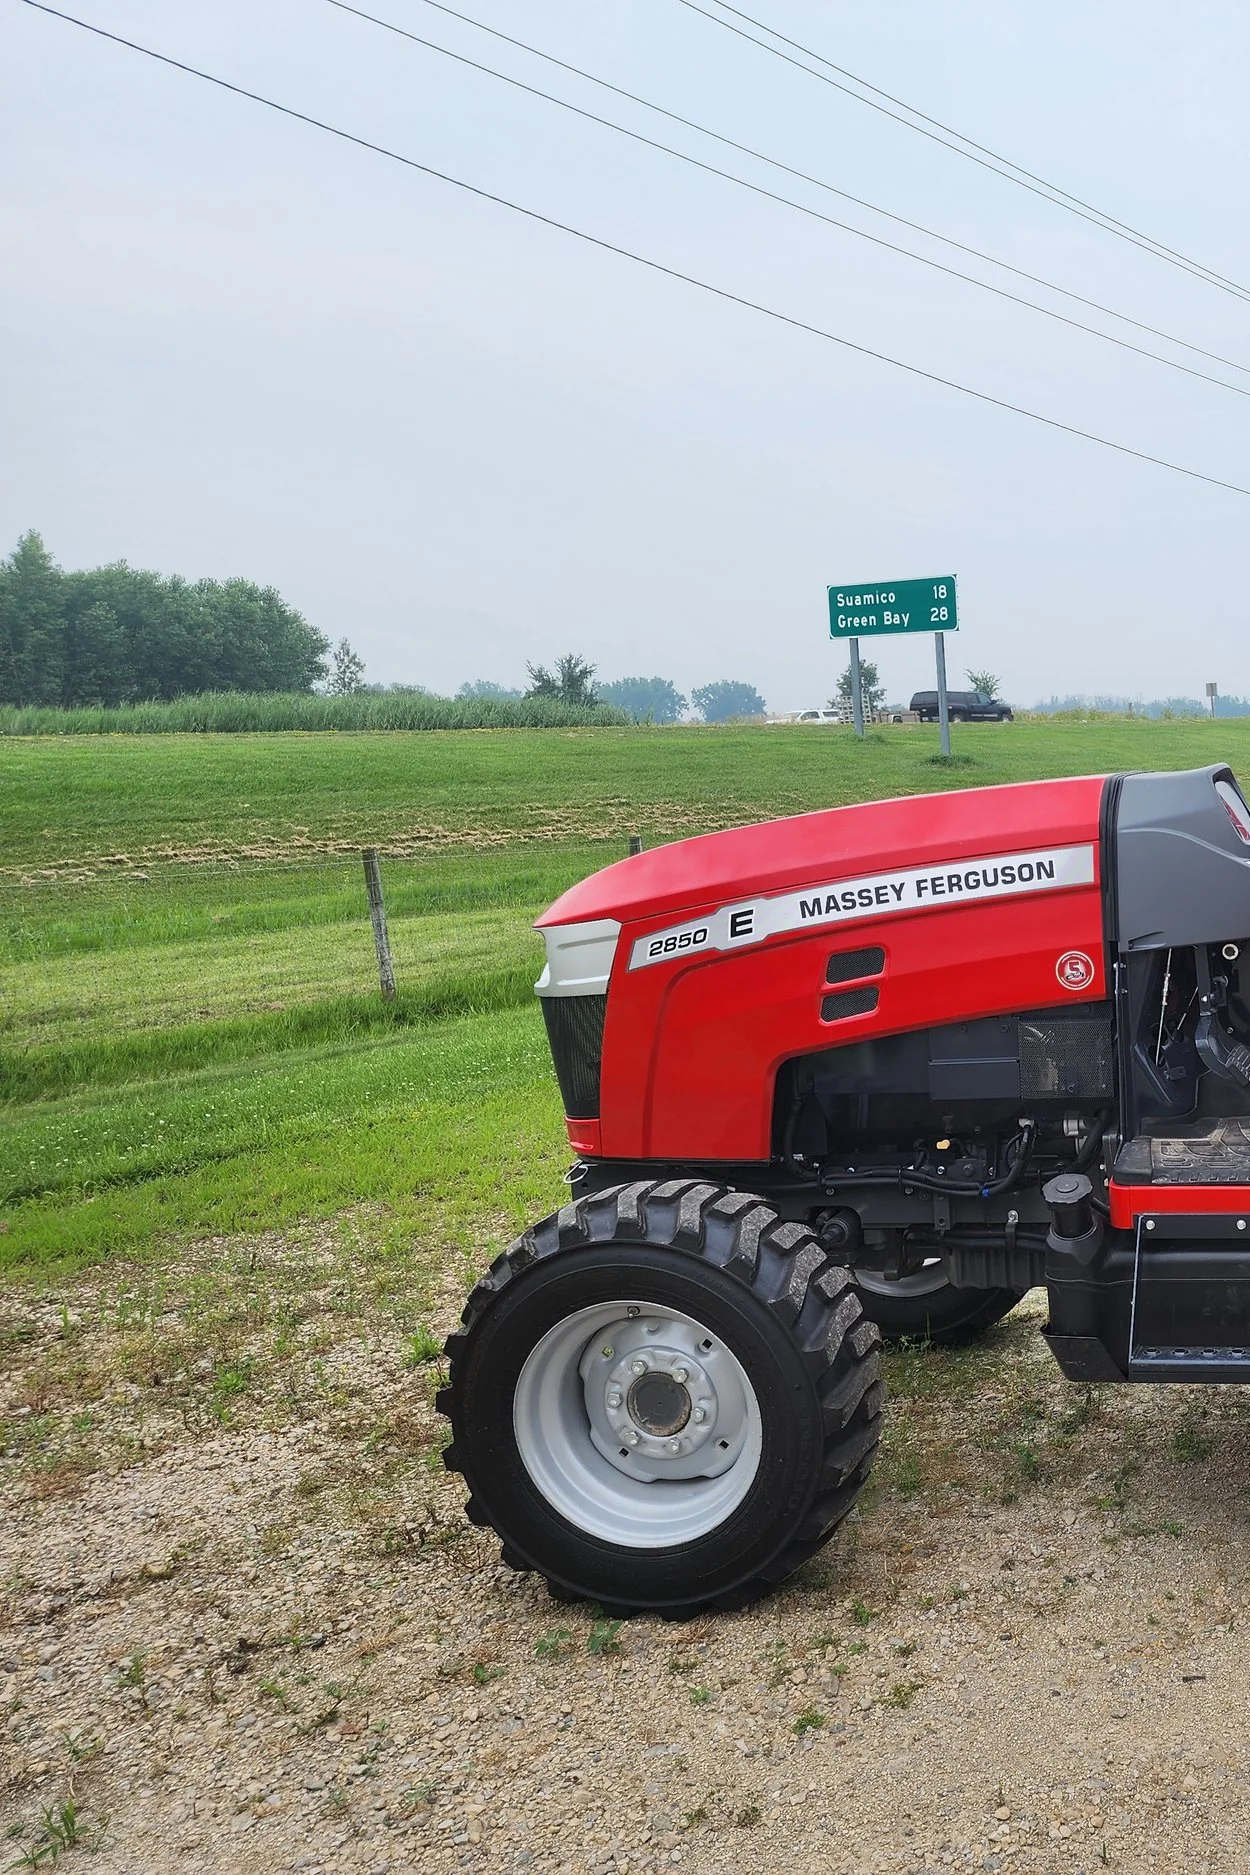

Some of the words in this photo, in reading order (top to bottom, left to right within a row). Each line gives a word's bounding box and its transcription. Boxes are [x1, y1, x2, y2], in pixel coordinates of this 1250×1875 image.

[837, 591, 896, 607] Suamico
[933, 585, 947, 600] 18
[838, 614, 877, 628] Green
[883, 611, 910, 627] Bay
[930, 607, 948, 621] 28
[648, 927, 708, 957] 2850
[729, 909, 755, 938] E
[799, 883, 905, 919] MASSEY
[915, 860, 1056, 899] FERGUSON
